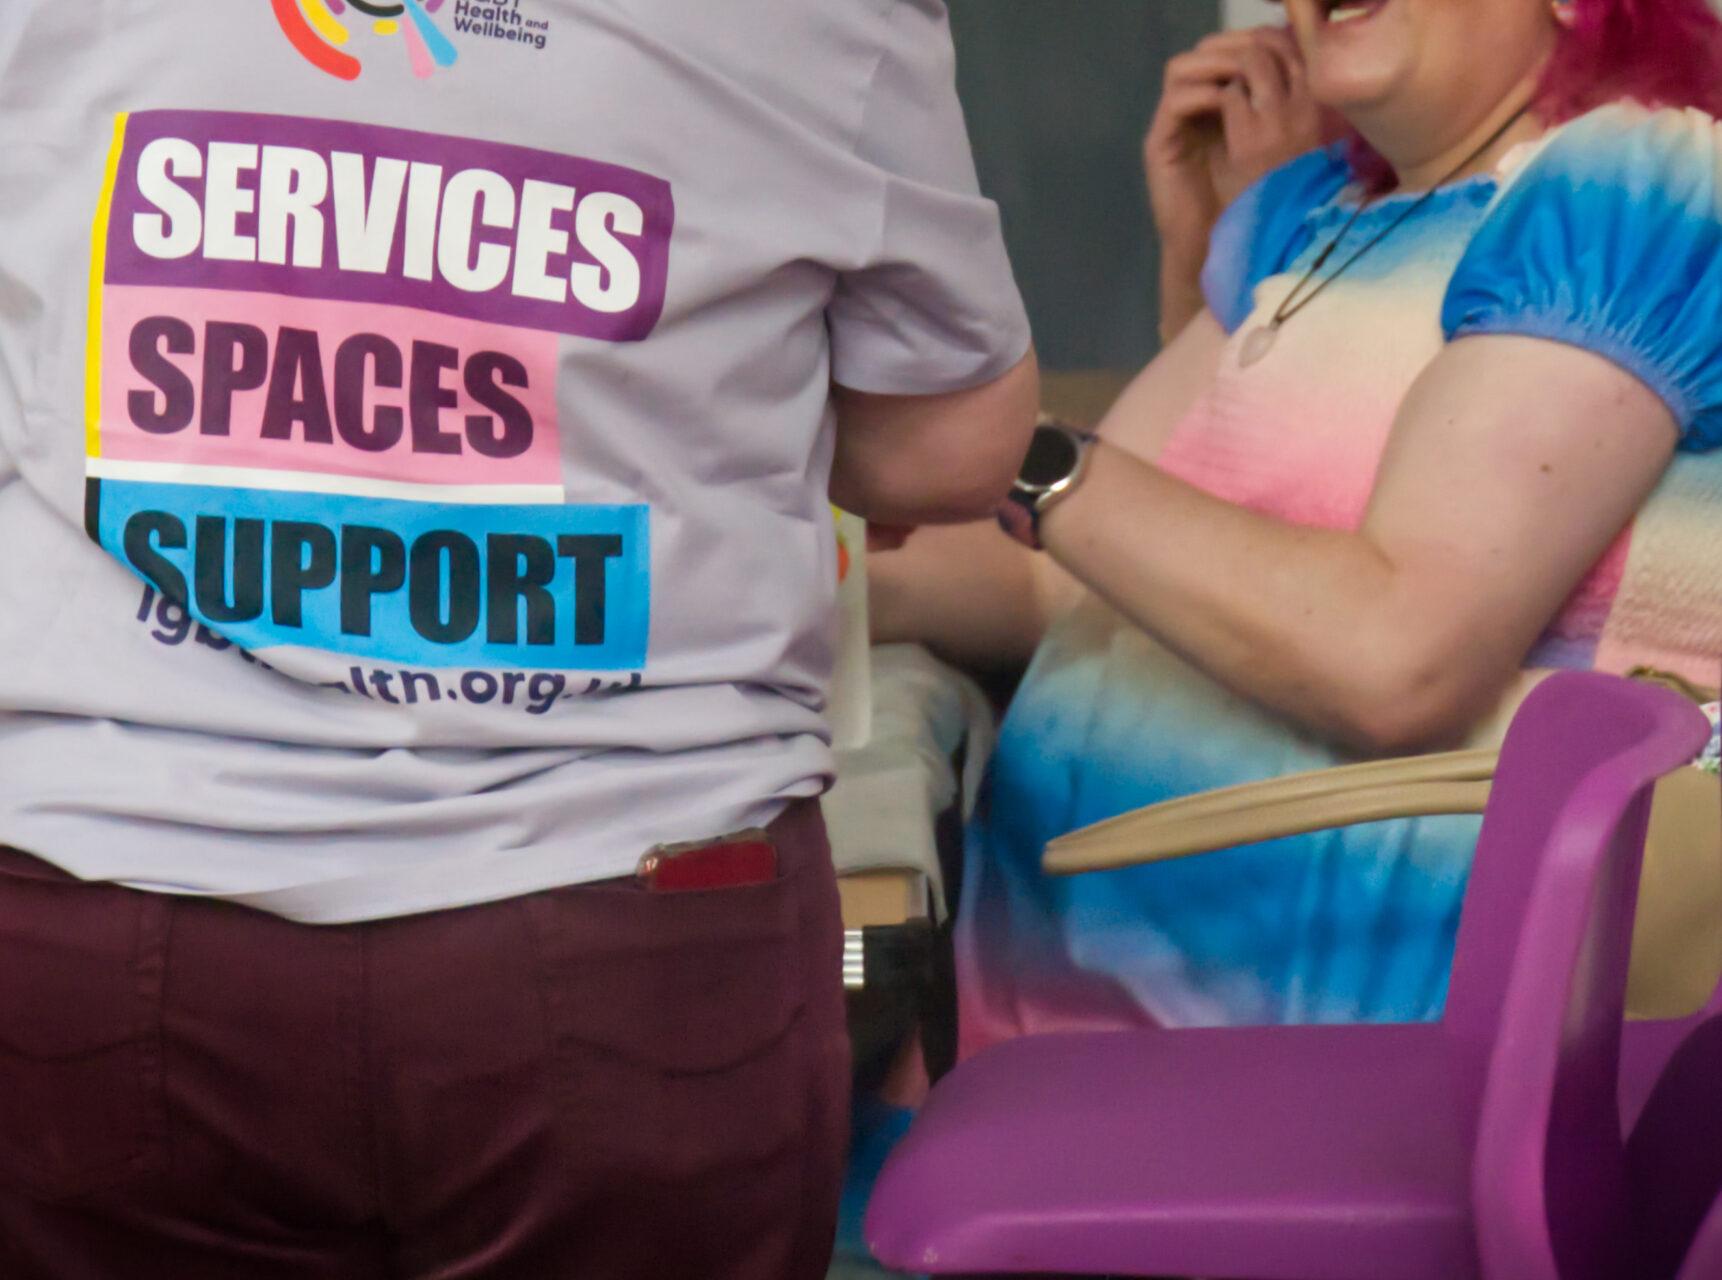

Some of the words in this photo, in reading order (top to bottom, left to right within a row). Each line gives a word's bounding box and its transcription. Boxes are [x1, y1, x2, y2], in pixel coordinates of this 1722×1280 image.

[454, 16, 547, 50] Wellbeing
[455, 0, 522, 25] Health
[525, 19, 549, 30] and
[132, 136, 643, 313] SERVICES
[127, 315, 533, 459] SPACES
[123, 509, 623, 646] SUPPORT
